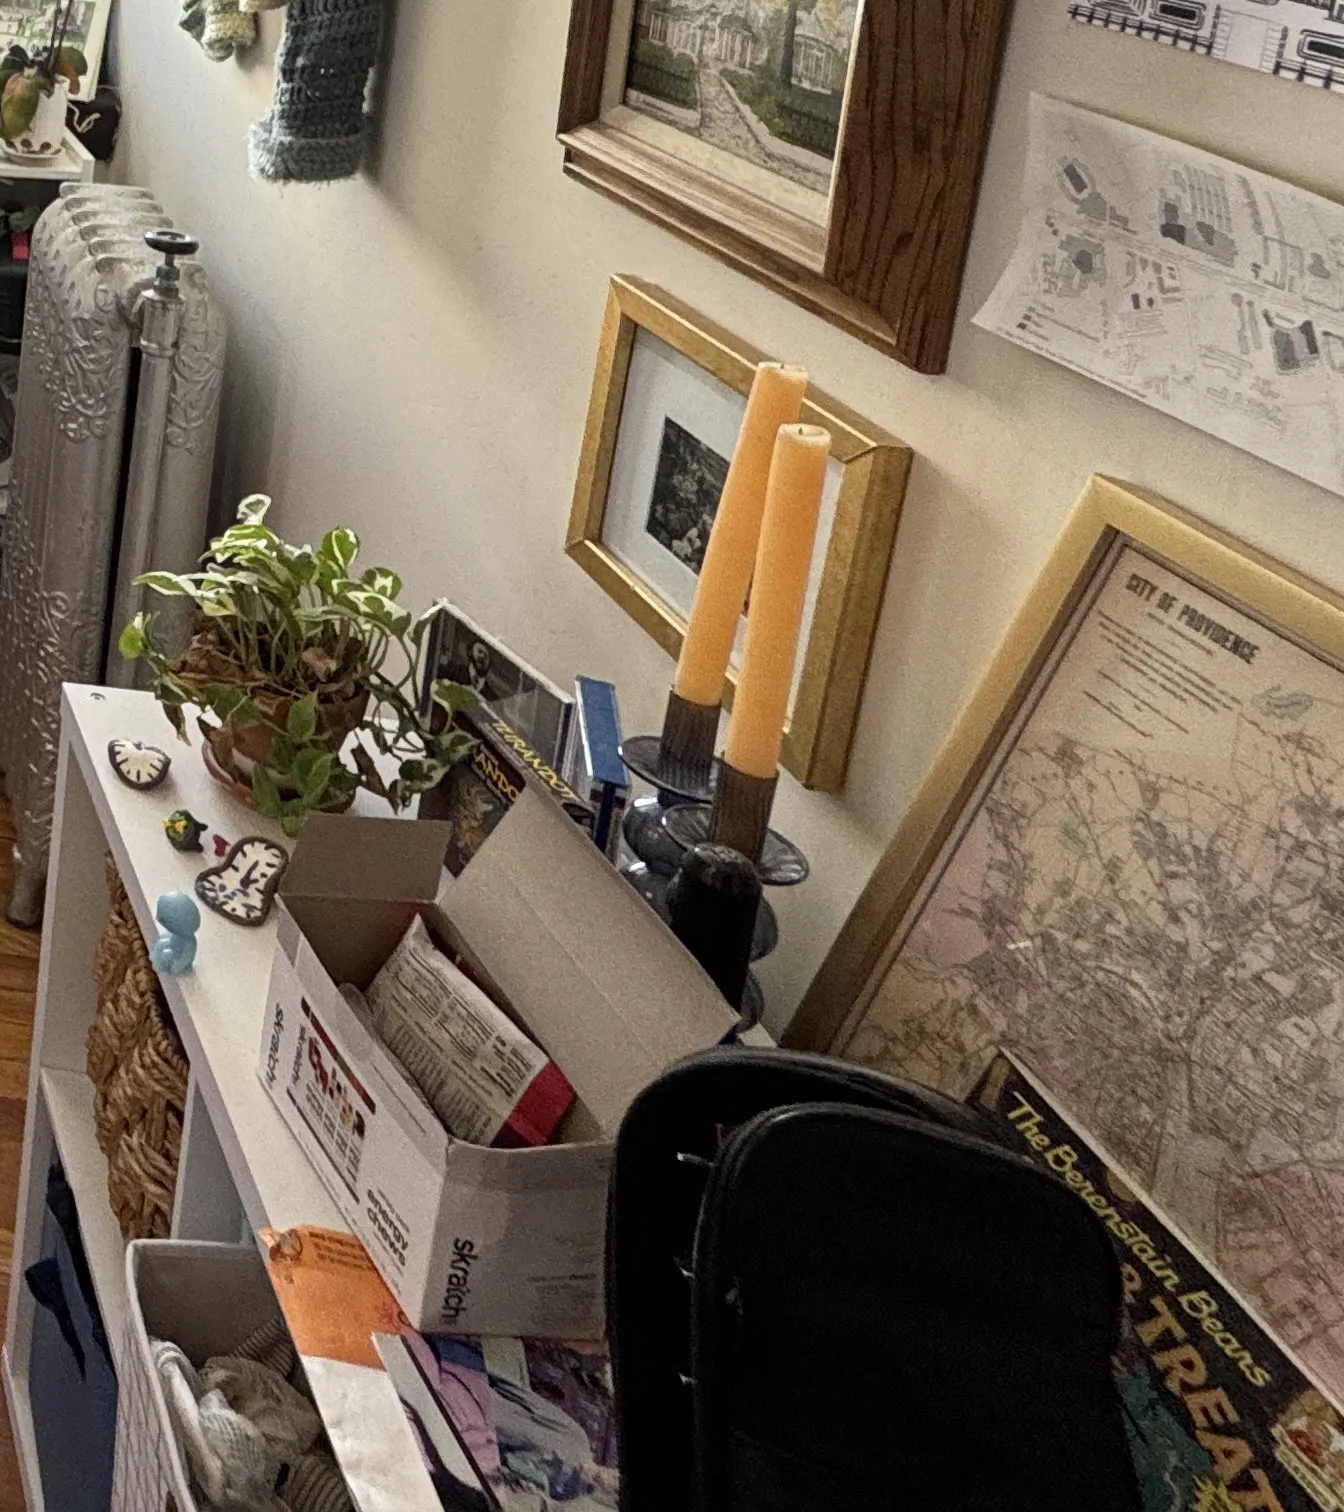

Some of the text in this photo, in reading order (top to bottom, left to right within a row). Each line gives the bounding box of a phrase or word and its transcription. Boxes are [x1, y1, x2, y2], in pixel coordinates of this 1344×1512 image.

[1125, 573, 1159, 602] CITY
[1156, 591, 1179, 614] OF
[1176, 604, 1261, 665] PROVIDENCE
[441, 1237, 475, 1324] skratch
[1007, 1090, 1272, 1387] The Berenstain Bears
